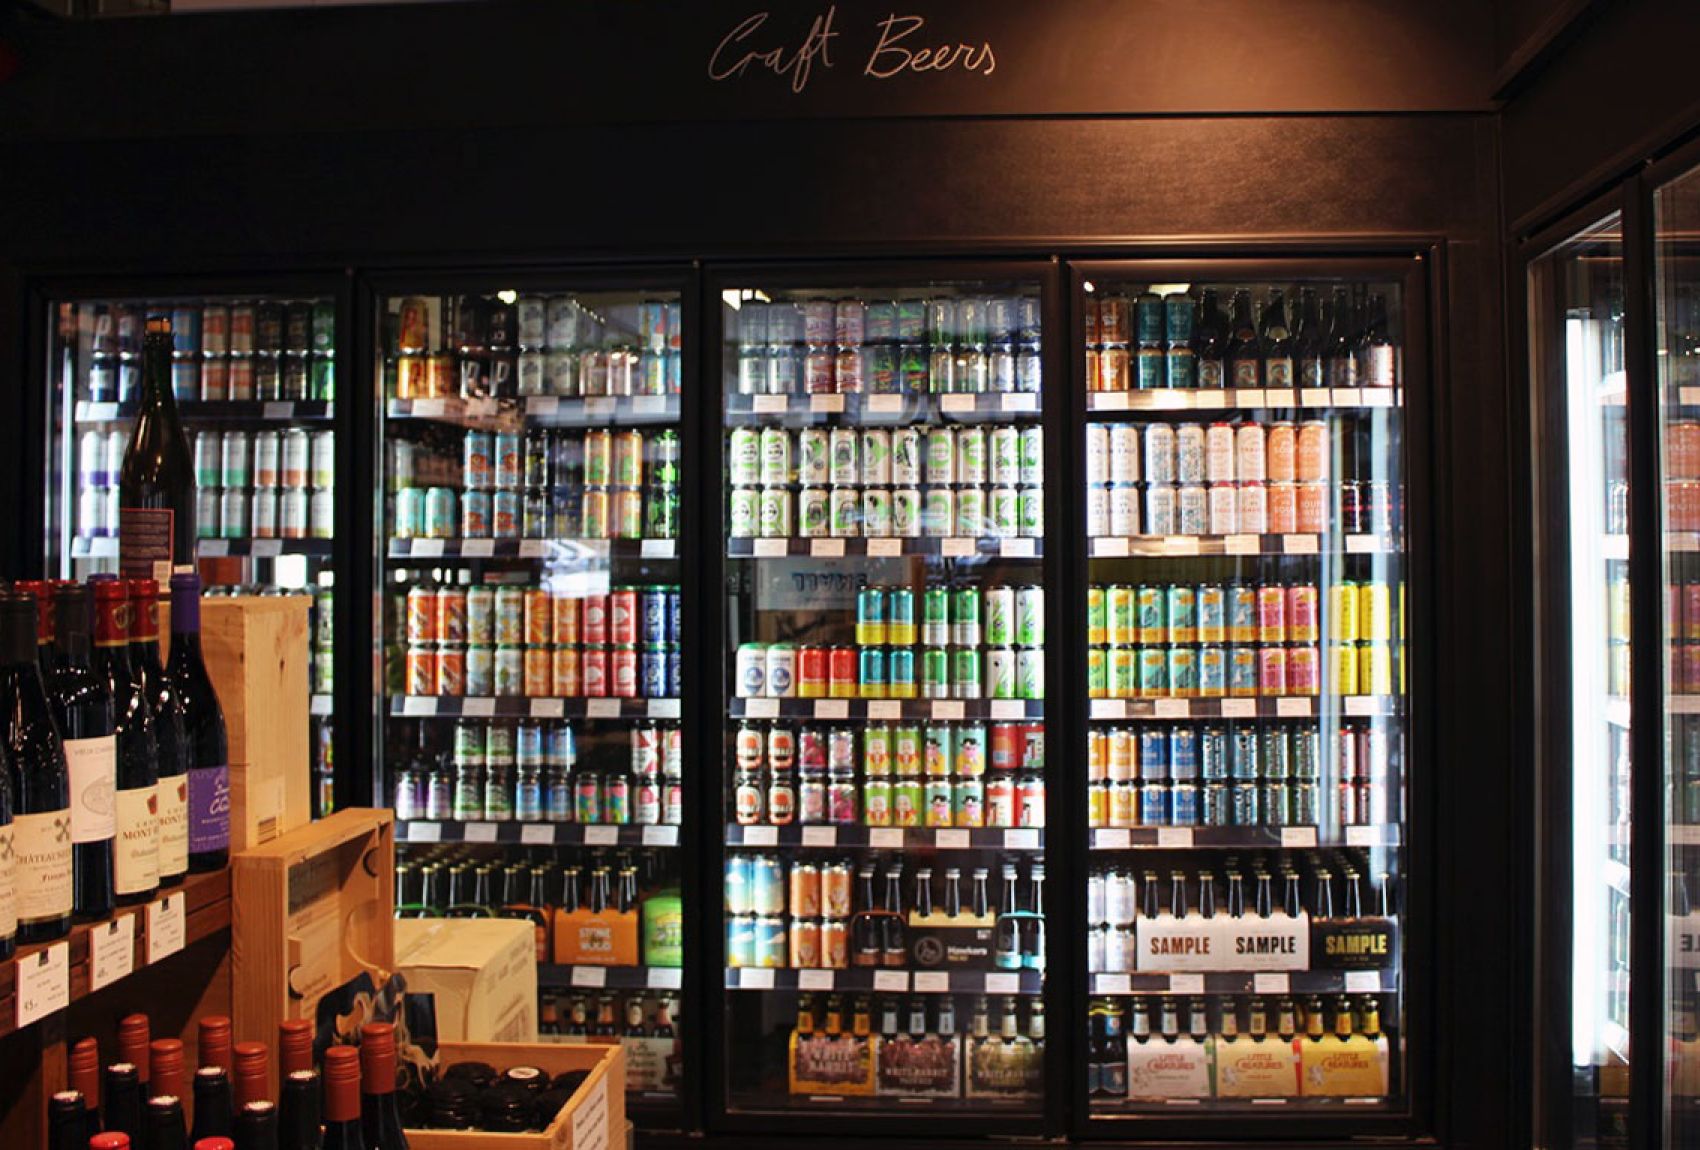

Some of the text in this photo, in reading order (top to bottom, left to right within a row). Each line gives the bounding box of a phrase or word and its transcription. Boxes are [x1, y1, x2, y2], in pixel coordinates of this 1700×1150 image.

[708, 5, 996, 93] Craft Beers
[1150, 936, 1210, 955] SAMPLE
[1236, 936, 1296, 954] SAMPLE
[1326, 934, 1388, 955] SAMPLE
